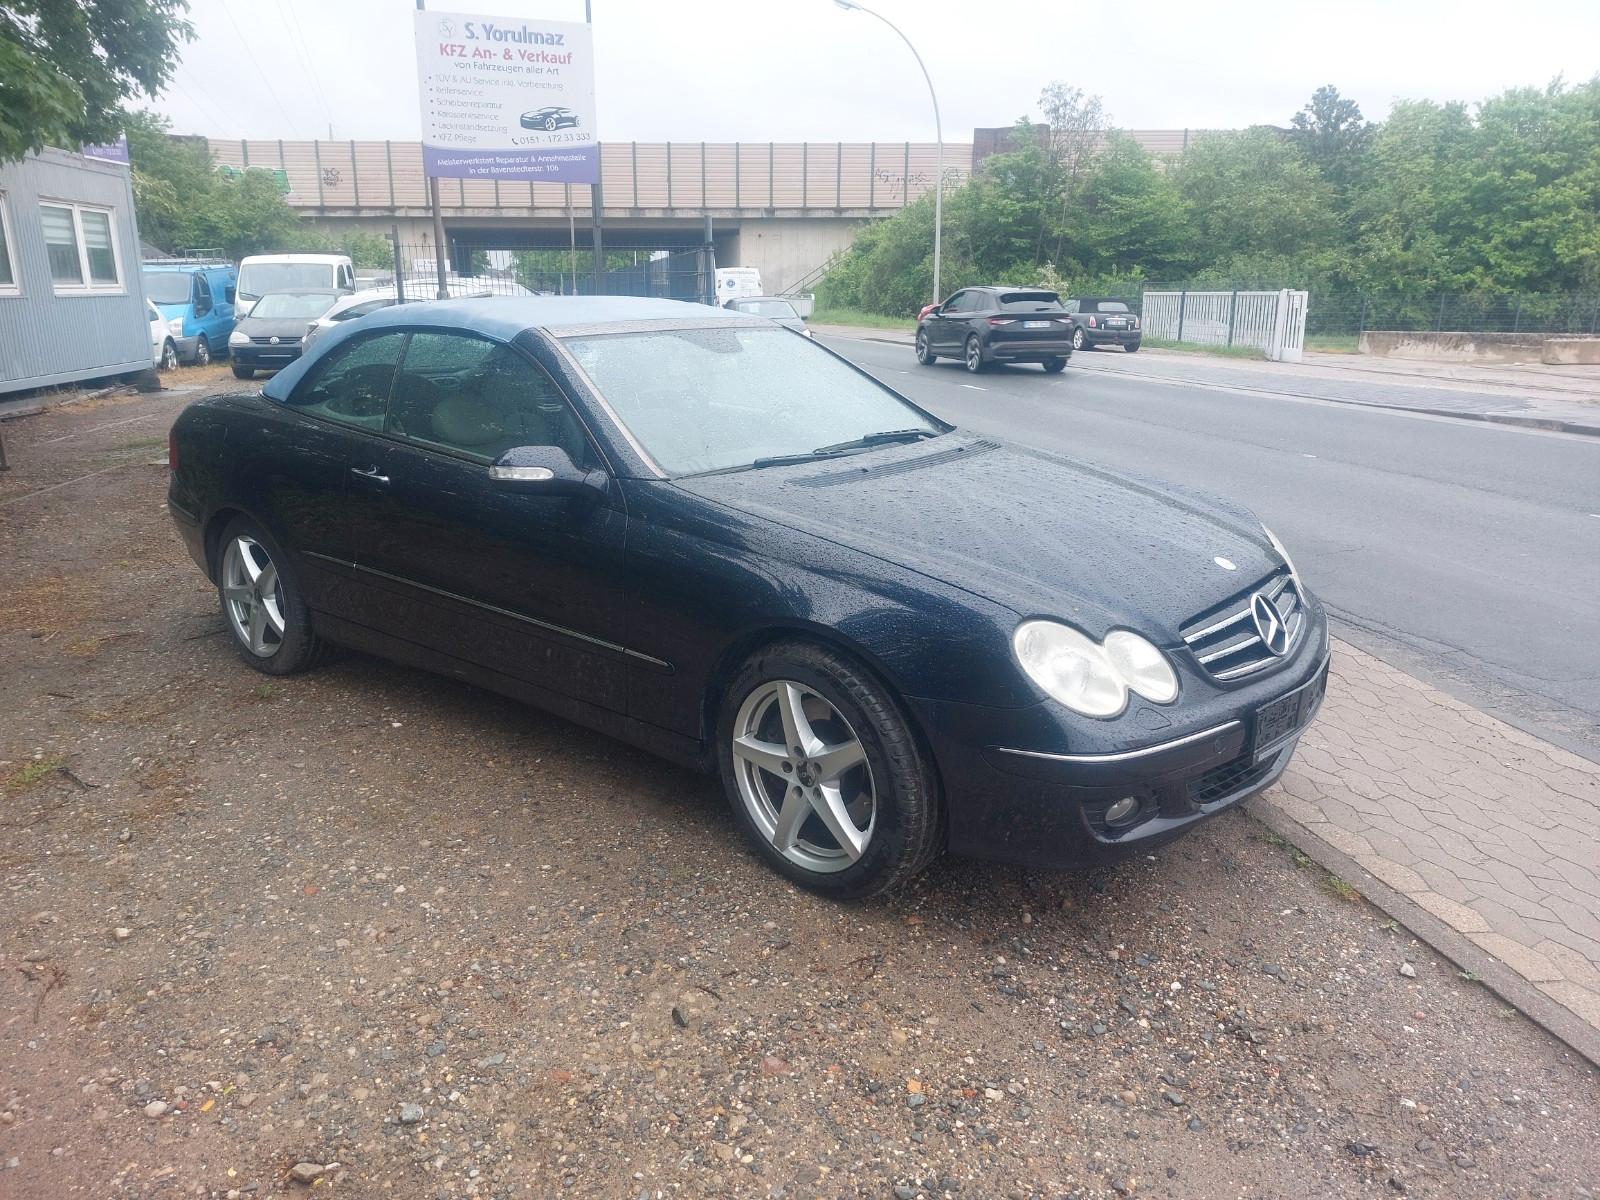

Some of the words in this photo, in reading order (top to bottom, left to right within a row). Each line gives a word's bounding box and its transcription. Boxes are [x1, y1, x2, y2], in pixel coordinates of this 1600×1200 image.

[464, 22, 480, 40] S.
[482, 24, 565, 46] Yorulmaz
[440, 43, 468, 58] KFZ
[472, 46, 497, 60] An-
[503, 48, 513, 60] &
[518, 50, 573, 64] Verkauf
[454, 62, 471, 70] von
[474, 61, 524, 74] Fahrzeugen
[526, 66, 544, 74] aller
[546, 67, 560, 76] Art
[436, 86, 484, 96] Reifenservice
[474, 76, 500, 86] Service
[517, 80, 564, 92] Vorbereitung
[520, 136, 540, 146] 0151
[548, 134, 562, 144] 172
[564, 133, 574, 142] 33
[576, 132, 591, 142] 333
[437, 157, 494, 166] Meisterwerkstatt
[496, 155, 530, 166] Reparatur
[478, 166, 490, 174] der
